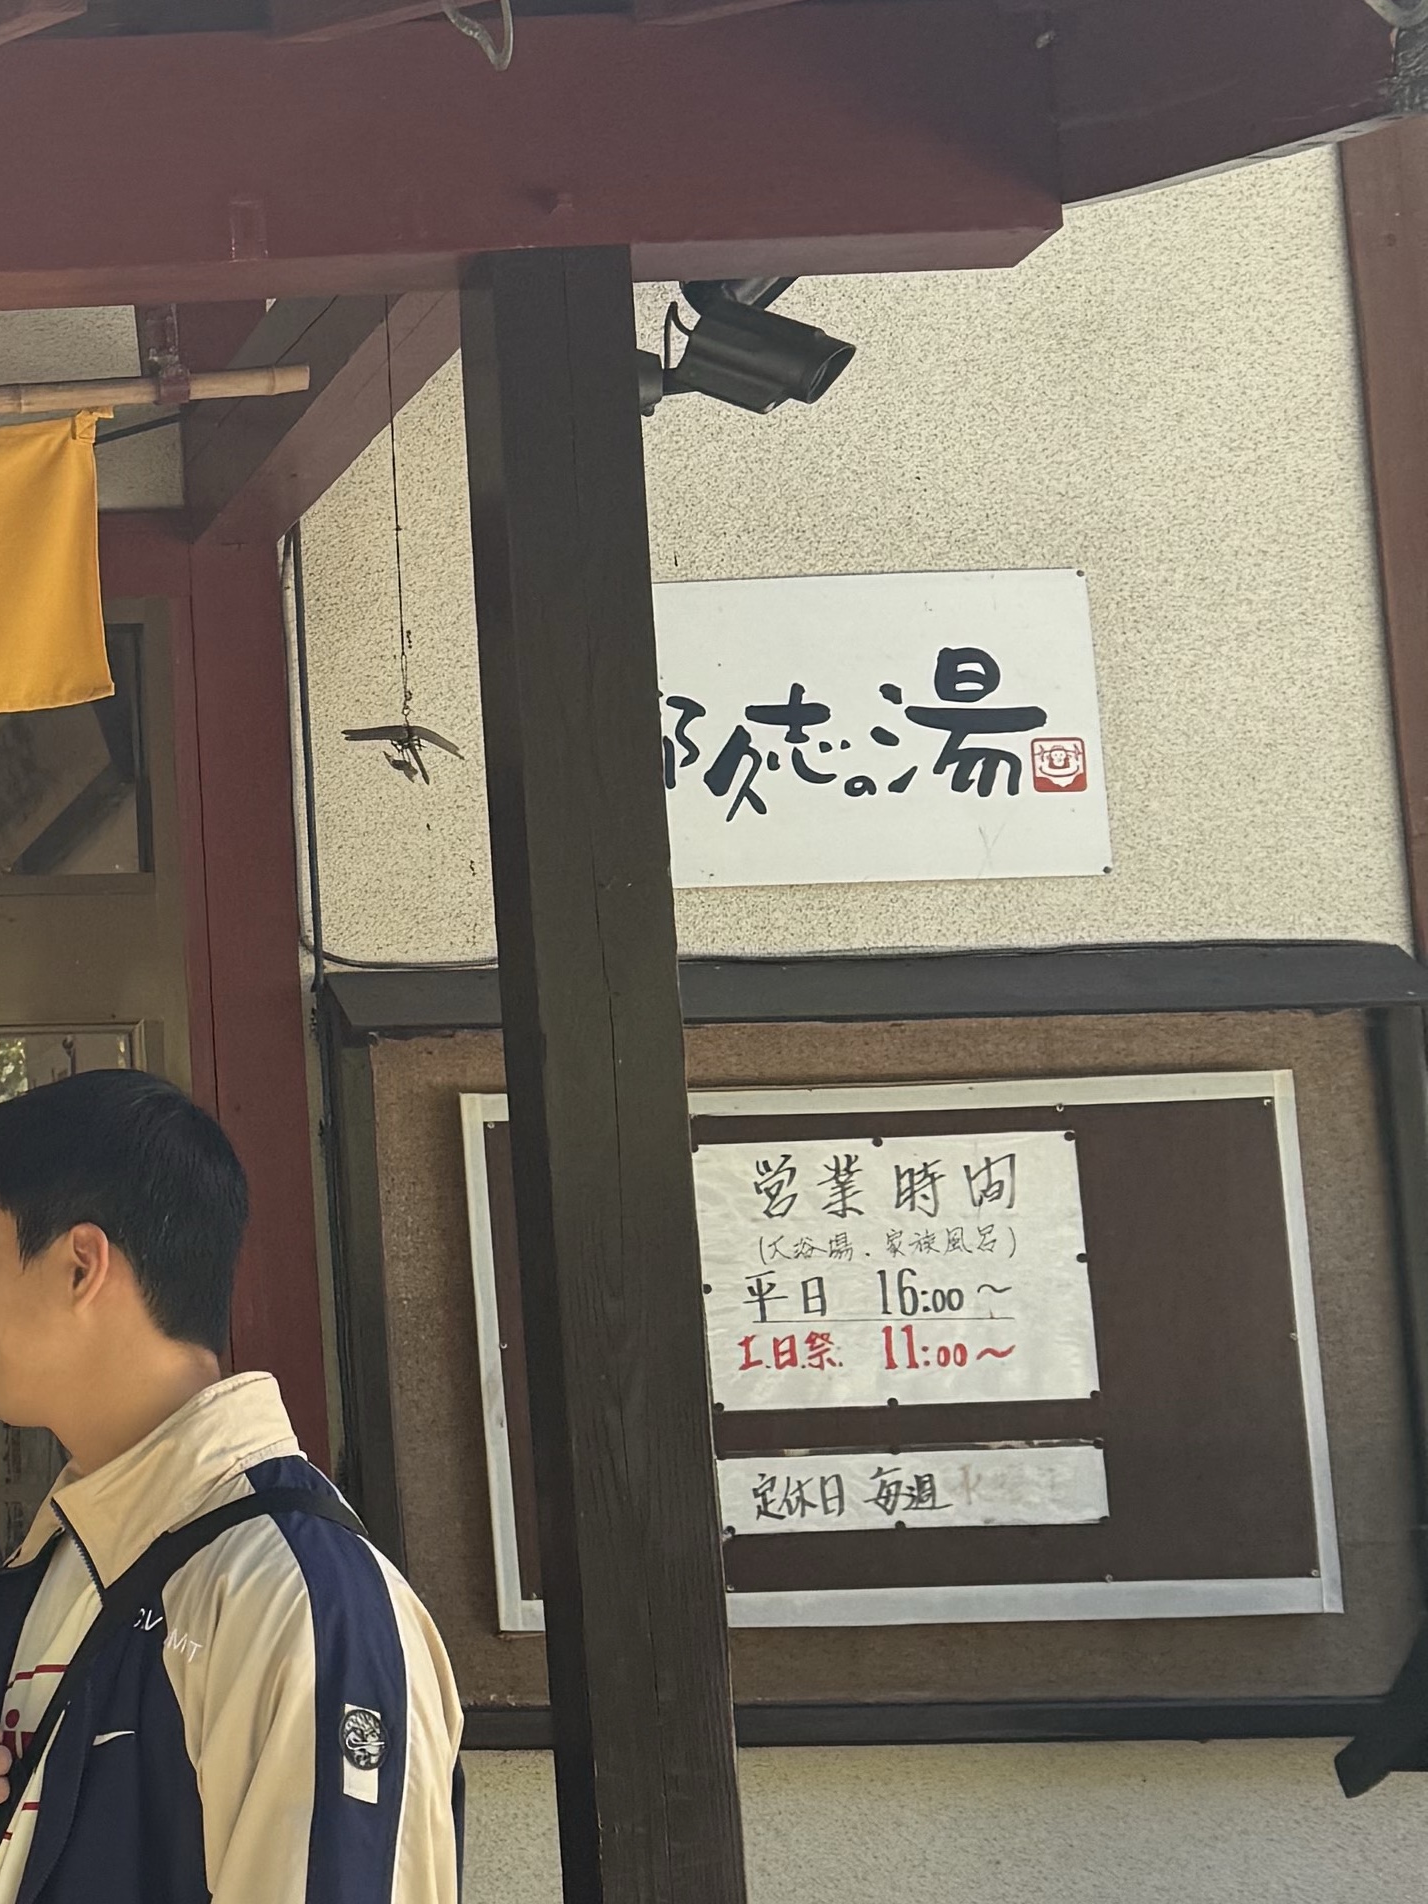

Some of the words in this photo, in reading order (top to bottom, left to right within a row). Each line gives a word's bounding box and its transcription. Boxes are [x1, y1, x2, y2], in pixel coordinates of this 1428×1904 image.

[754, 1153, 1017, 1219] 営業時間
[743, 1270, 827, 1322] 平日
[752, 1473, 847, 1520] 定休日
[863, 1467, 953, 1517] 毎週
